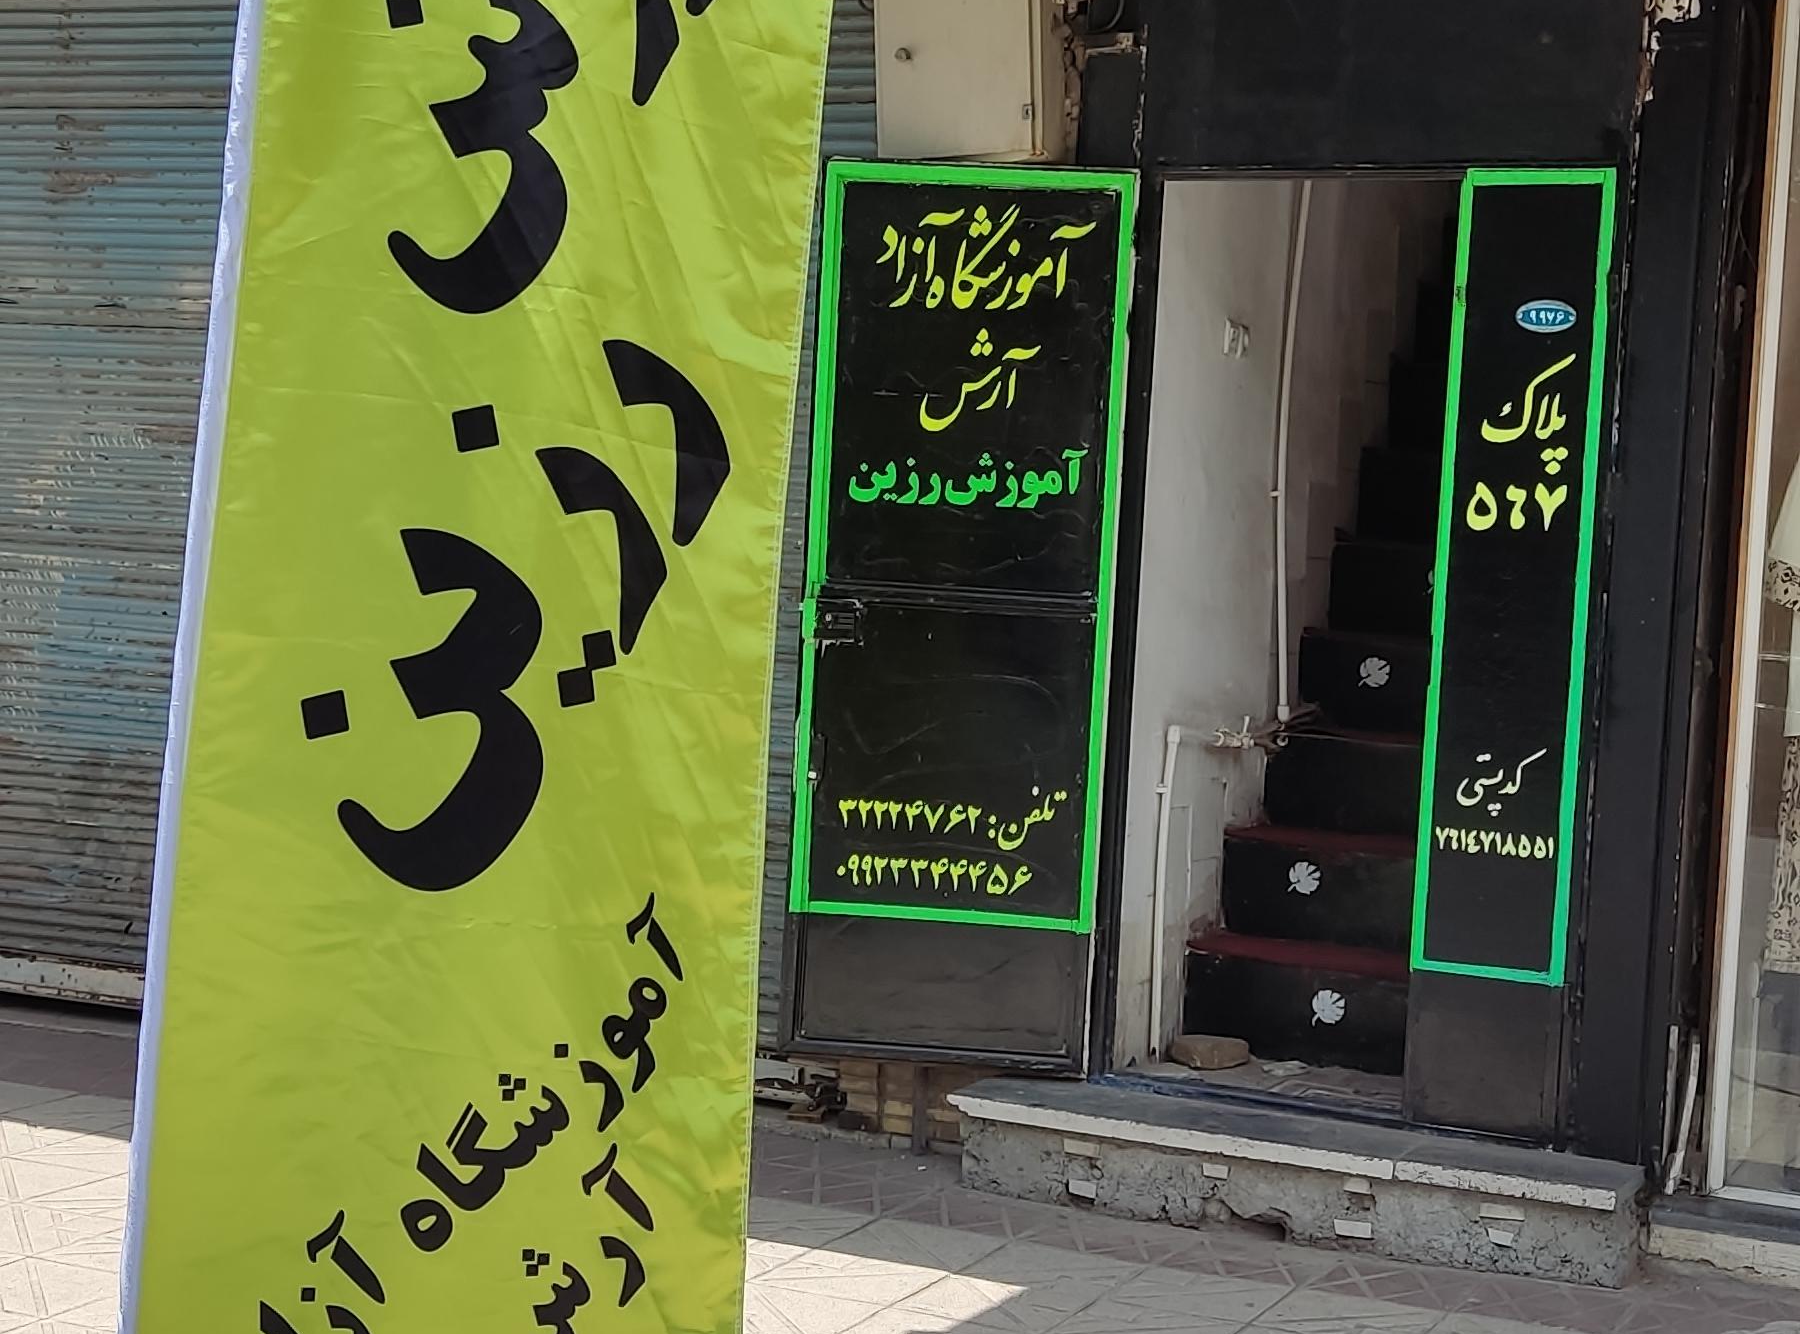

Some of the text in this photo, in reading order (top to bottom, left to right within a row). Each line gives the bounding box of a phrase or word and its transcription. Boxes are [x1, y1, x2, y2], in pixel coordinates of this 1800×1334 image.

[875, 203, 1097, 311] آموزشگاه آزاد
[918, 327, 1042, 432] آرش
[1481, 353, 1577, 476] پلاک
[848, 448, 1090, 509] آموزش رزین
[300, 338, 731, 892] رزین
[838, 798, 982, 835] ۳۲۲۲۴۷۶۲
[836, 853, 1033, 896] ۰۹۹۲۳۳۴۴۴۵۶
[400, 891, 684, 1253] آموزشگاه
